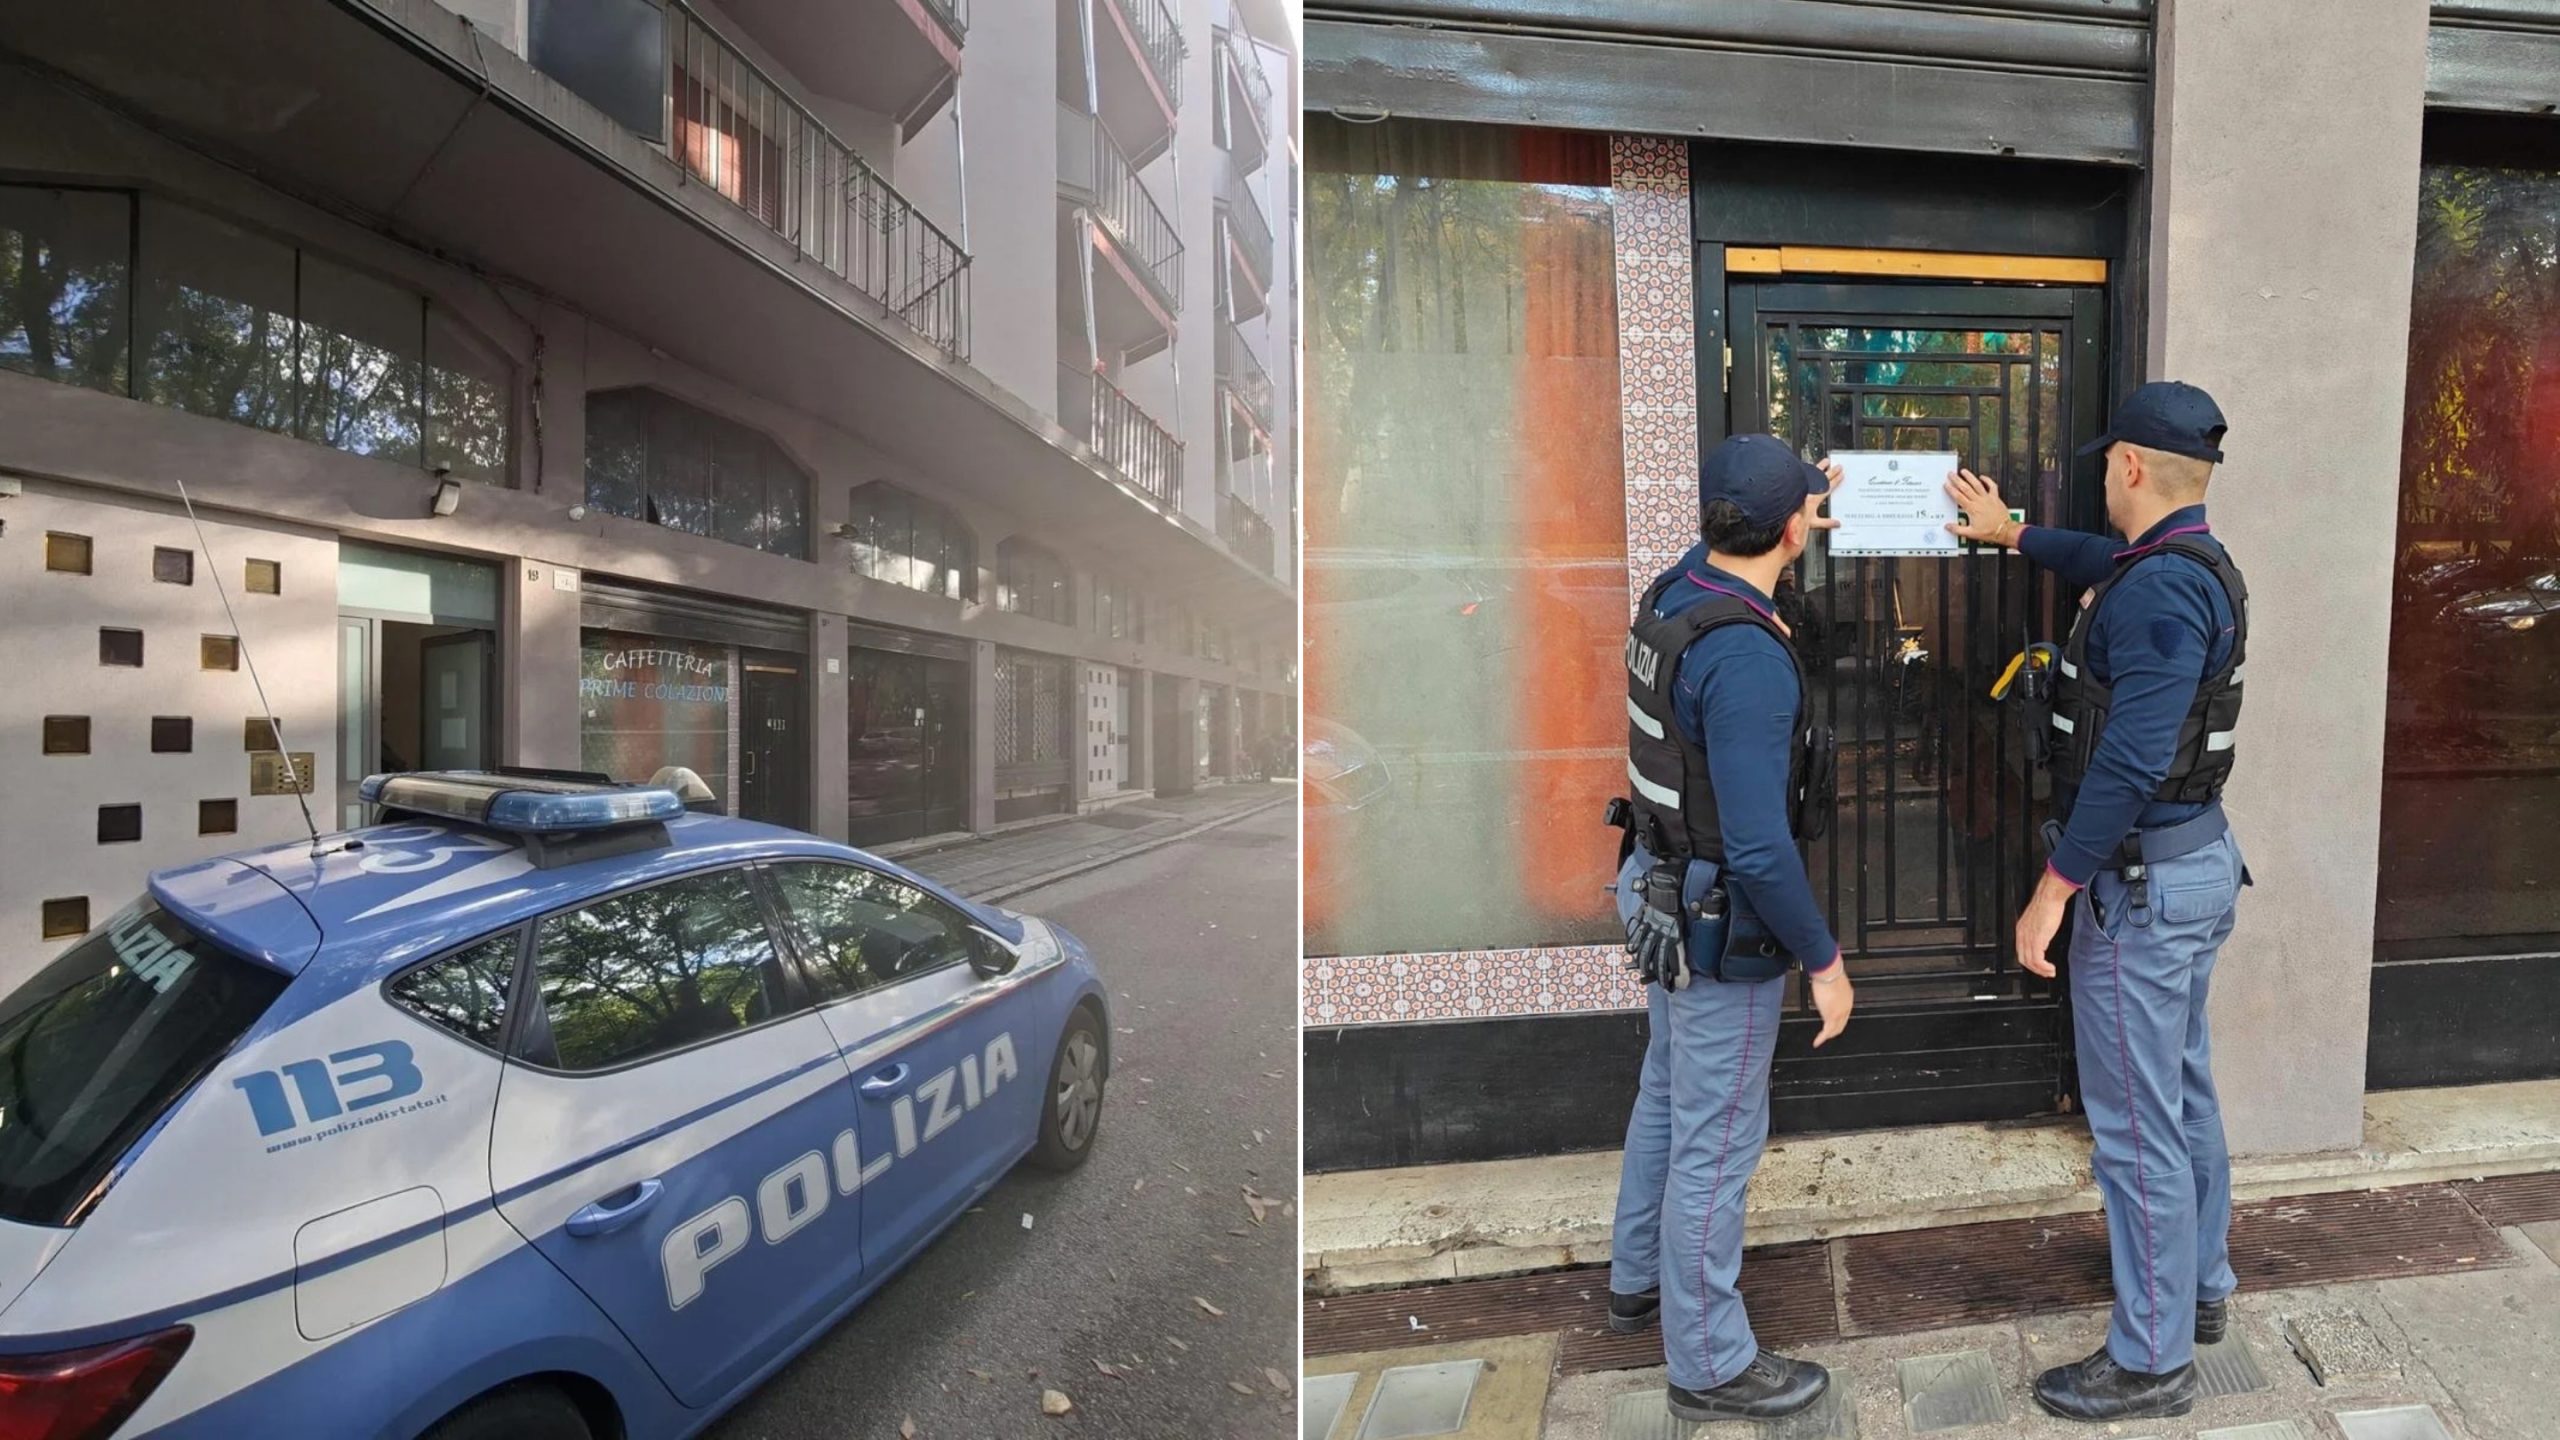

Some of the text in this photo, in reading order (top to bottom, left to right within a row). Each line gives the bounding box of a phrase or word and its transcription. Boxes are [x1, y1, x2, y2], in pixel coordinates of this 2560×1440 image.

[527, 569, 540, 581] 19
[603, 649, 713, 677] CAFFETTERIA
[579, 676, 637, 699] PRIME
[232, 1039, 424, 1137] 113
[266, 1094, 448, 1154] www.poliziadistato.it
[661, 1031, 1019, 1312] POLIZIA
